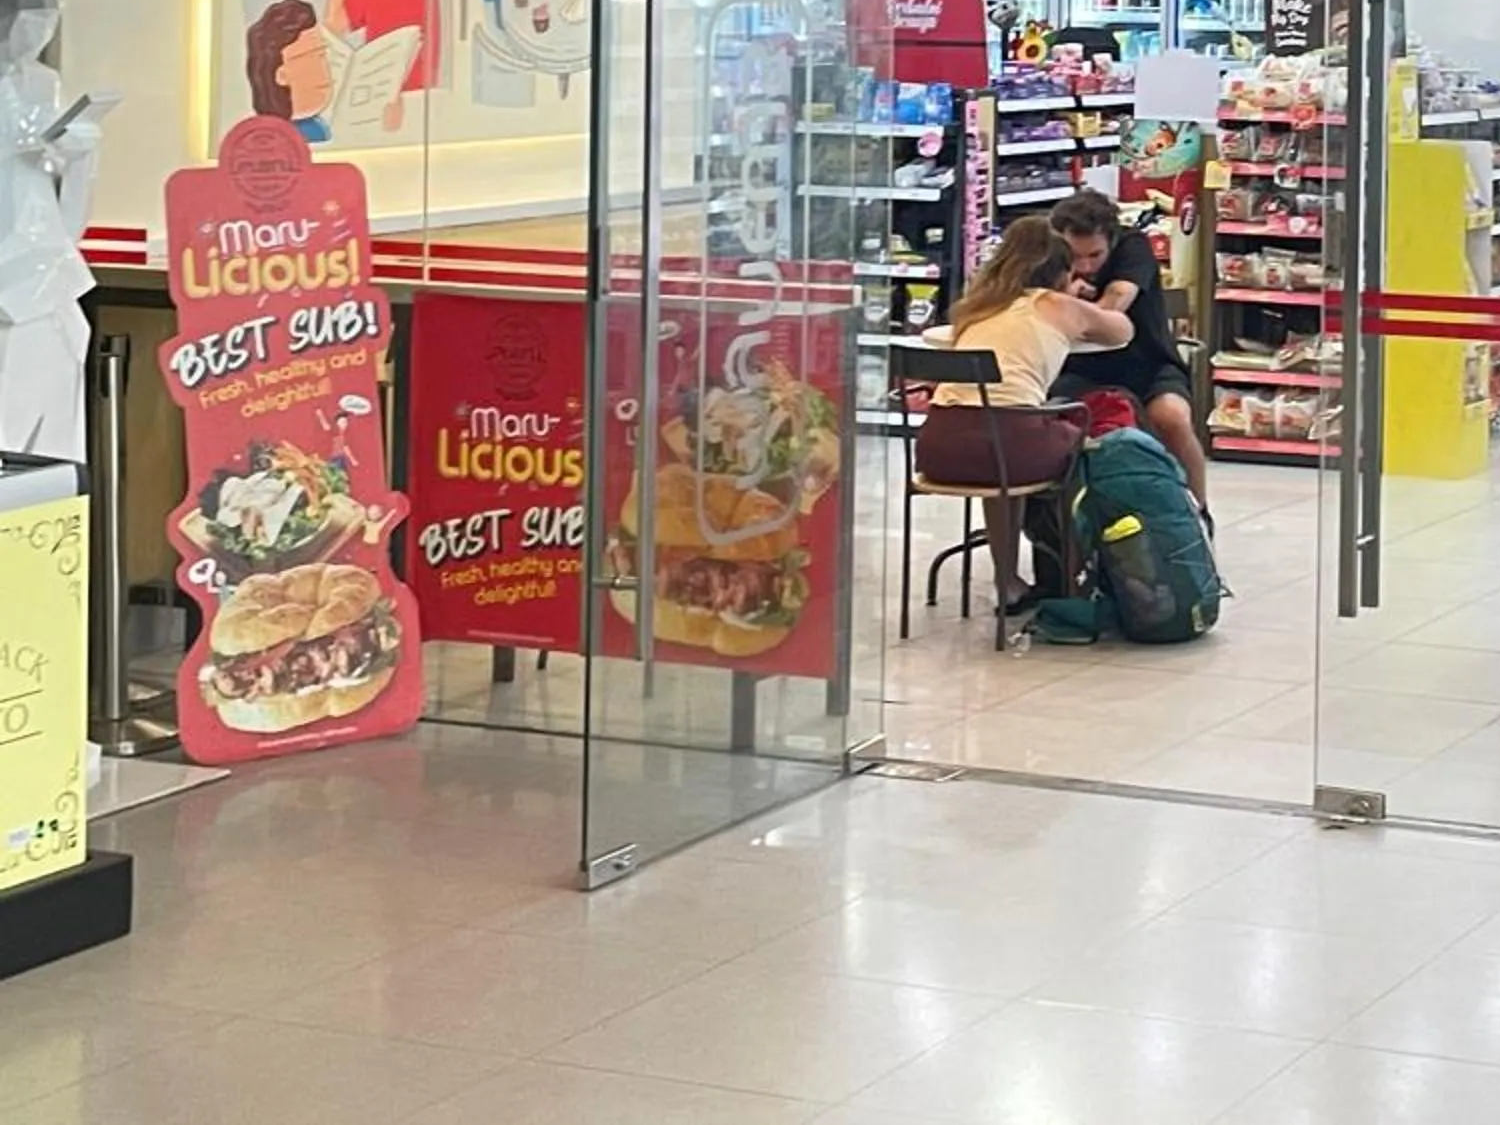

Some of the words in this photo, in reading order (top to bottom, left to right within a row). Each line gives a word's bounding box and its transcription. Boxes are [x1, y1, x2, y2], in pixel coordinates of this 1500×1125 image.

[181, 237, 361, 300] Licious!
[169, 315, 278, 388] BEST
[288, 300, 380, 353] SUB!
[255, 357, 327, 388] healthy
[329, 349, 367, 371] and
[418, 508, 513, 566] BEST
[489, 556, 554, 578] healthy
